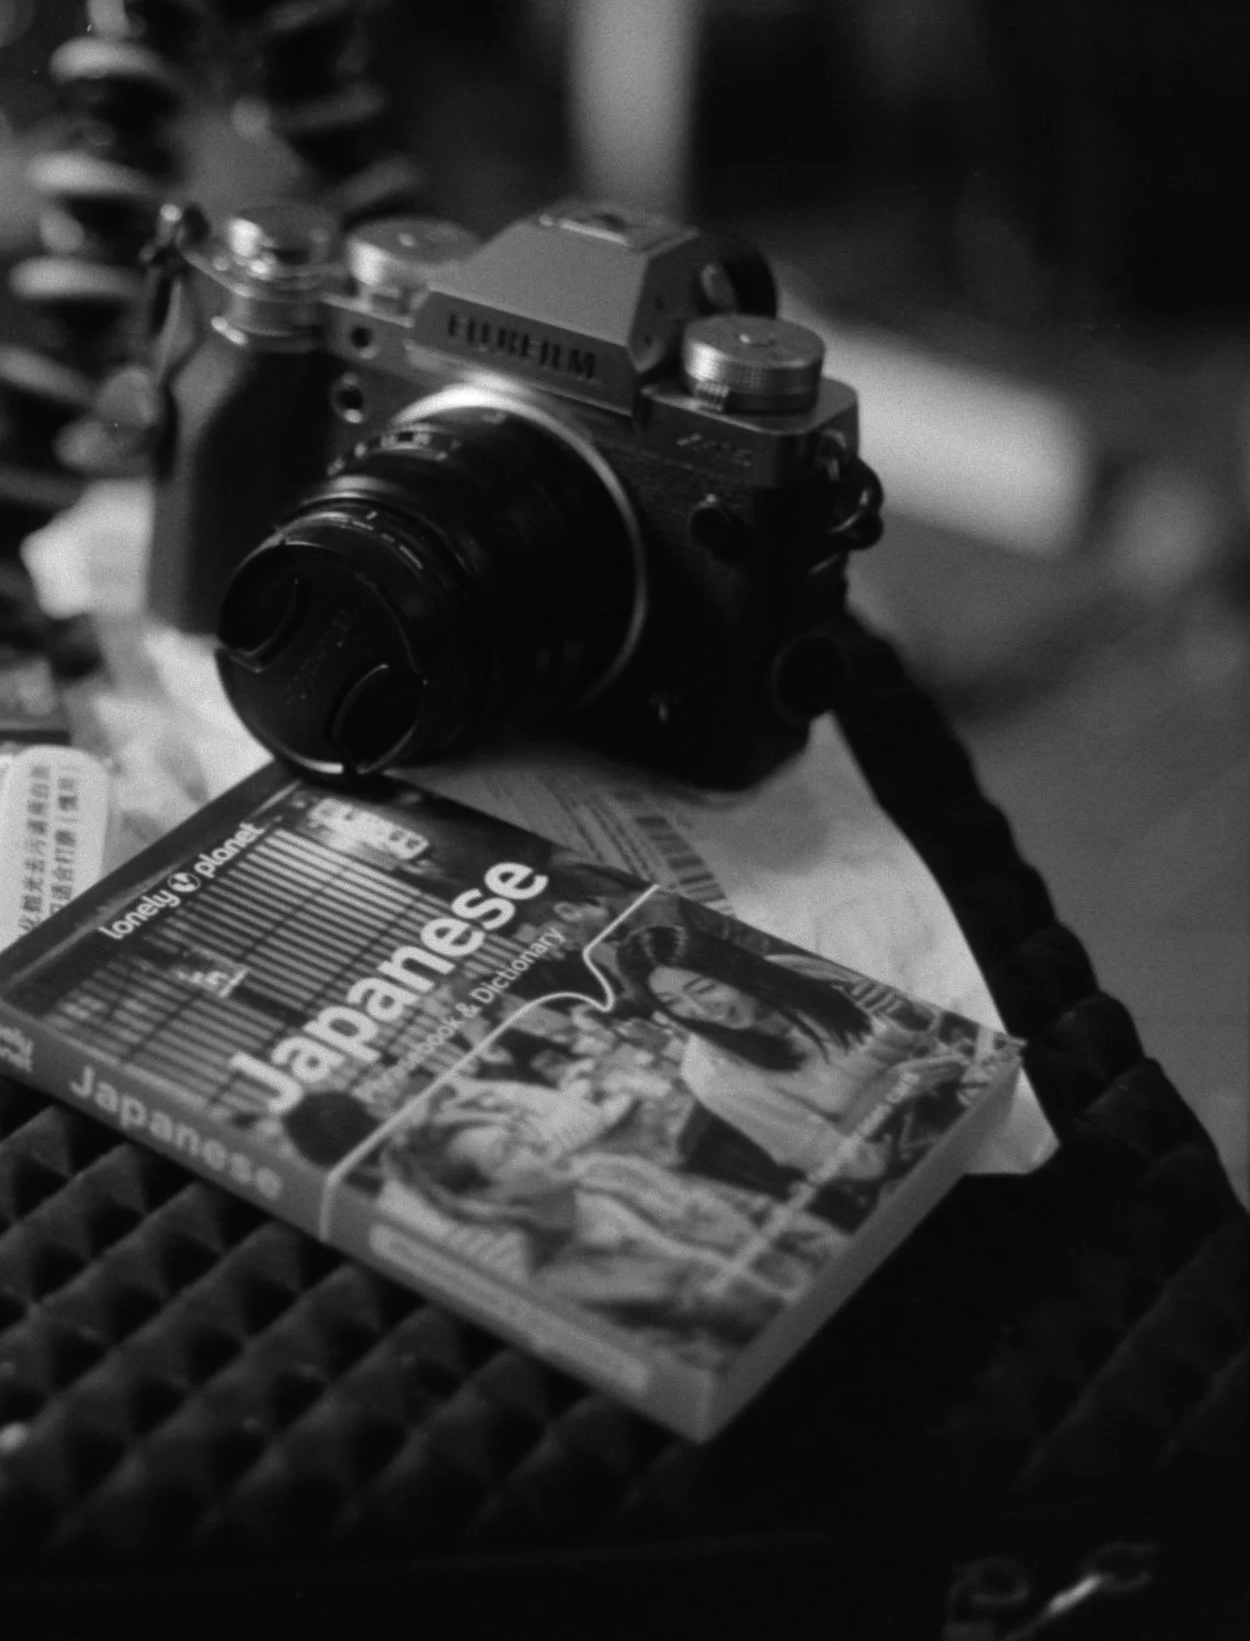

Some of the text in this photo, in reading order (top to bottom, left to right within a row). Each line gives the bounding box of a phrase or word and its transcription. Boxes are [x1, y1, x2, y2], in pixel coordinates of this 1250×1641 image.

[448, 313, 597, 382] FUJIFILM
[98, 889, 181, 941] lonely
[194, 822, 266, 879] planet
[230, 861, 548, 1114] Japanese
[468, 926, 567, 1005] Dictionary
[454, 1001, 483, 1018] &
